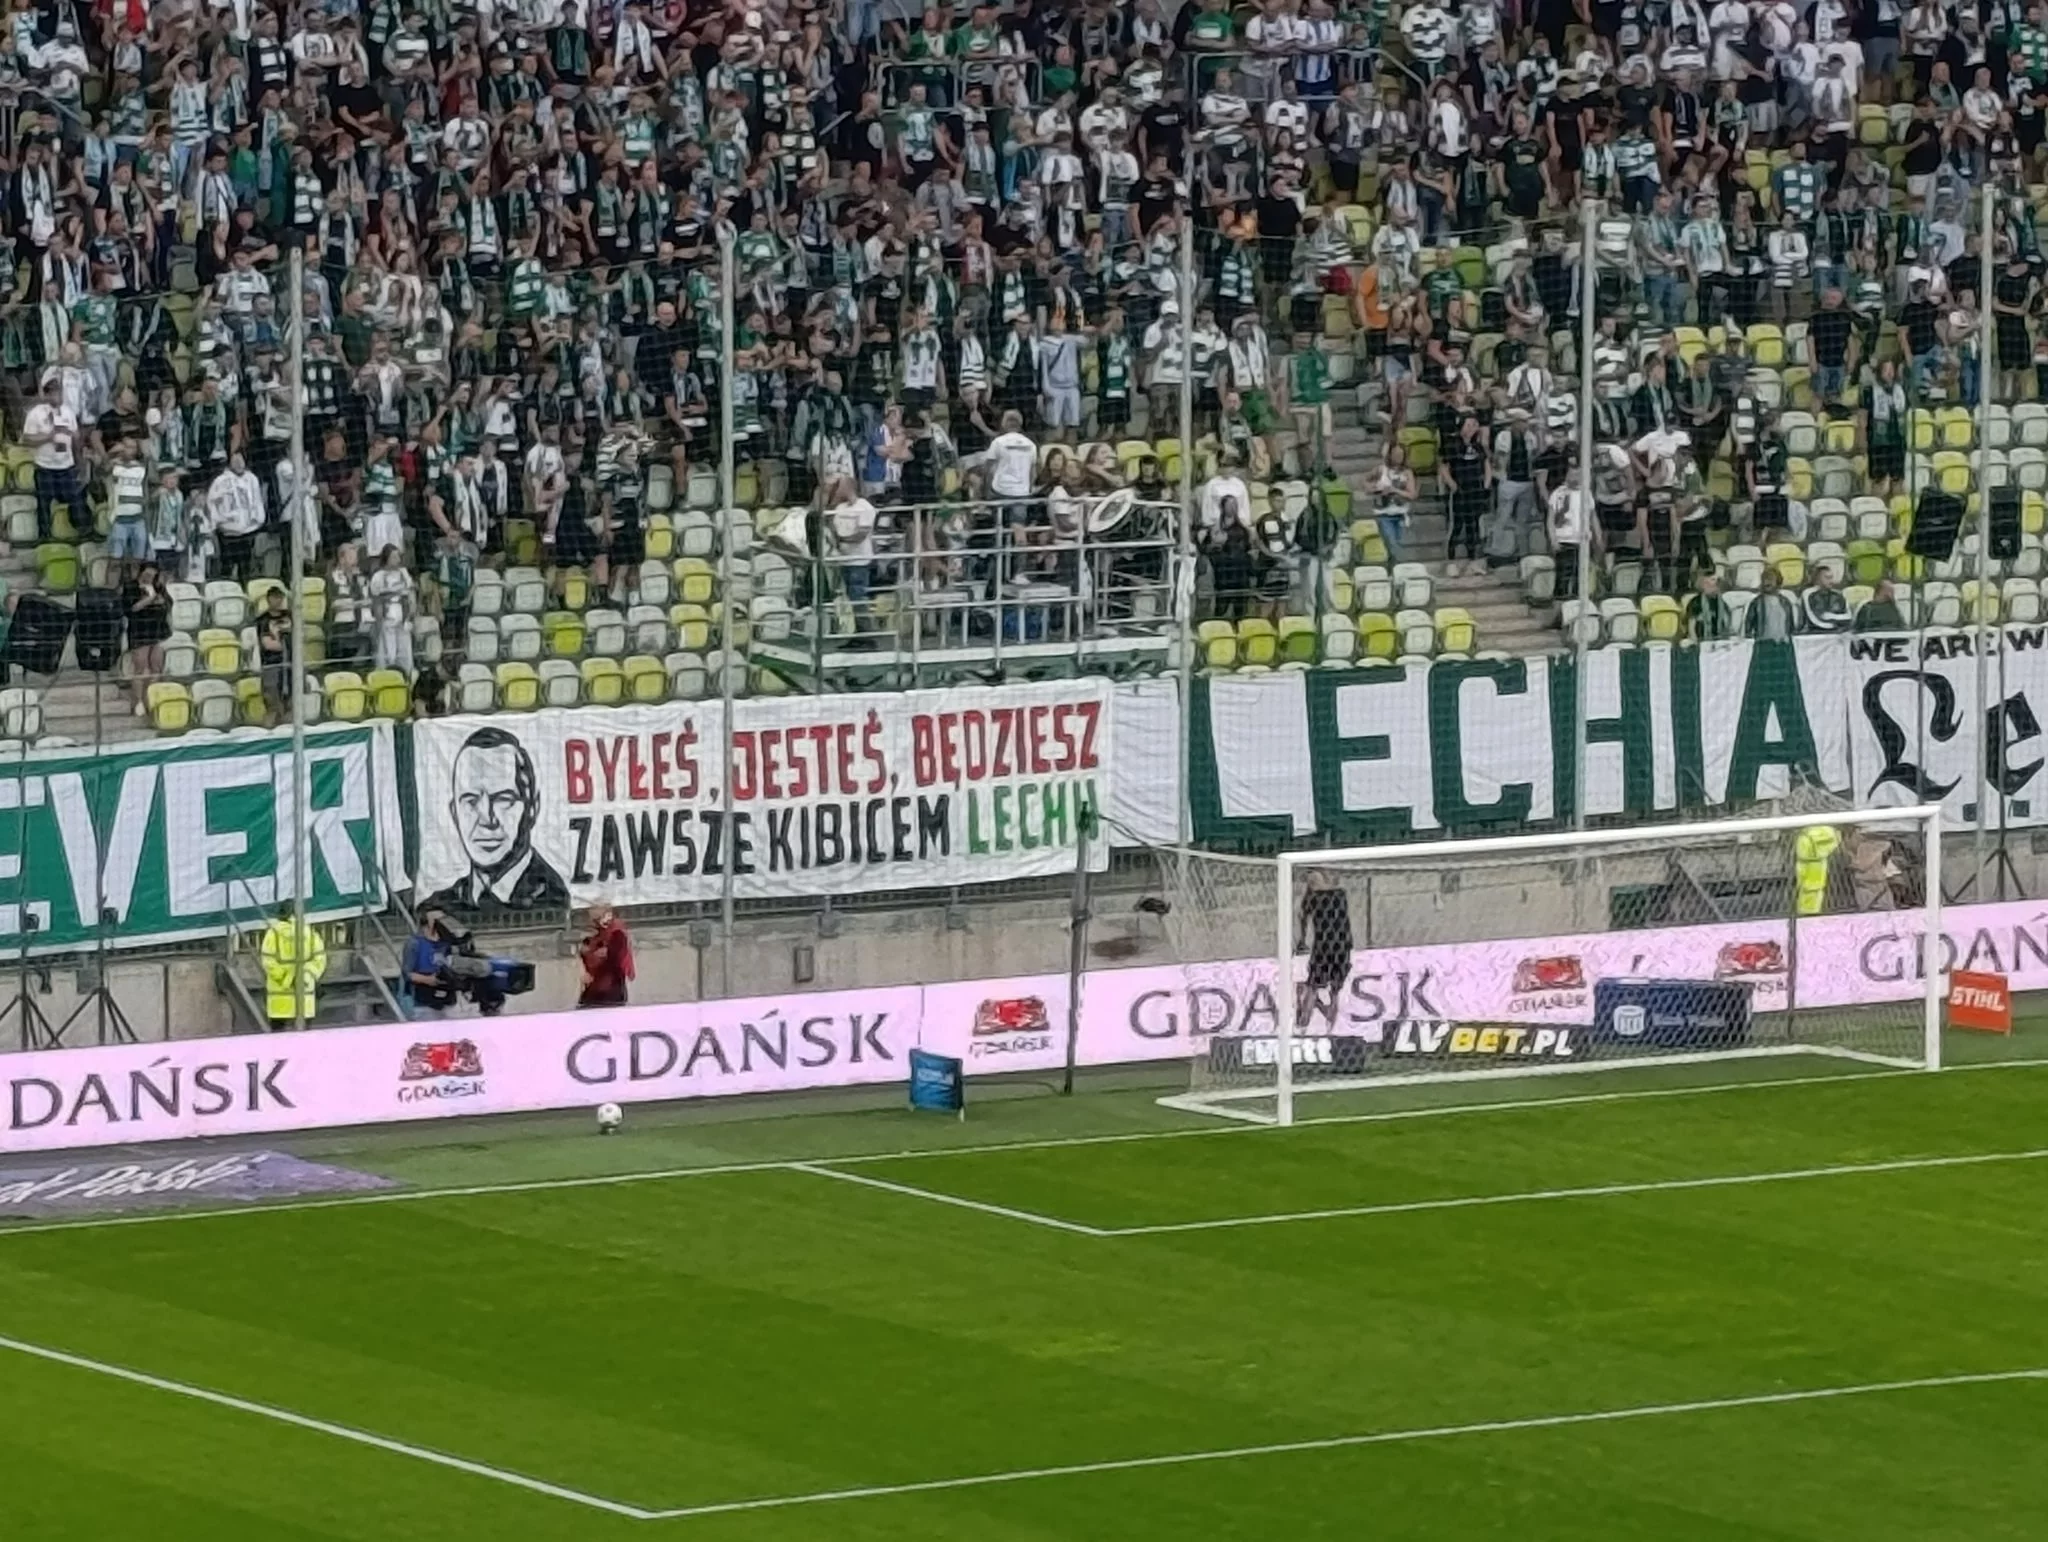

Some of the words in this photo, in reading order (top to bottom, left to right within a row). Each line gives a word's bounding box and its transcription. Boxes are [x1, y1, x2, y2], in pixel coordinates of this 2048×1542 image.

[1850, 638, 1909, 662] WE
[1923, 632, 1997, 661] ARE
[912, 701, 1103, 792] BĘDZIESZ
[1189, 636, 1826, 841] LECHIA
[569, 808, 756, 884] ZAWSZE
[767, 794, 950, 872] KIBICEM
[1950, 986, 2006, 1012] STIHL
[566, 1009, 895, 1084] GDAŃSK
